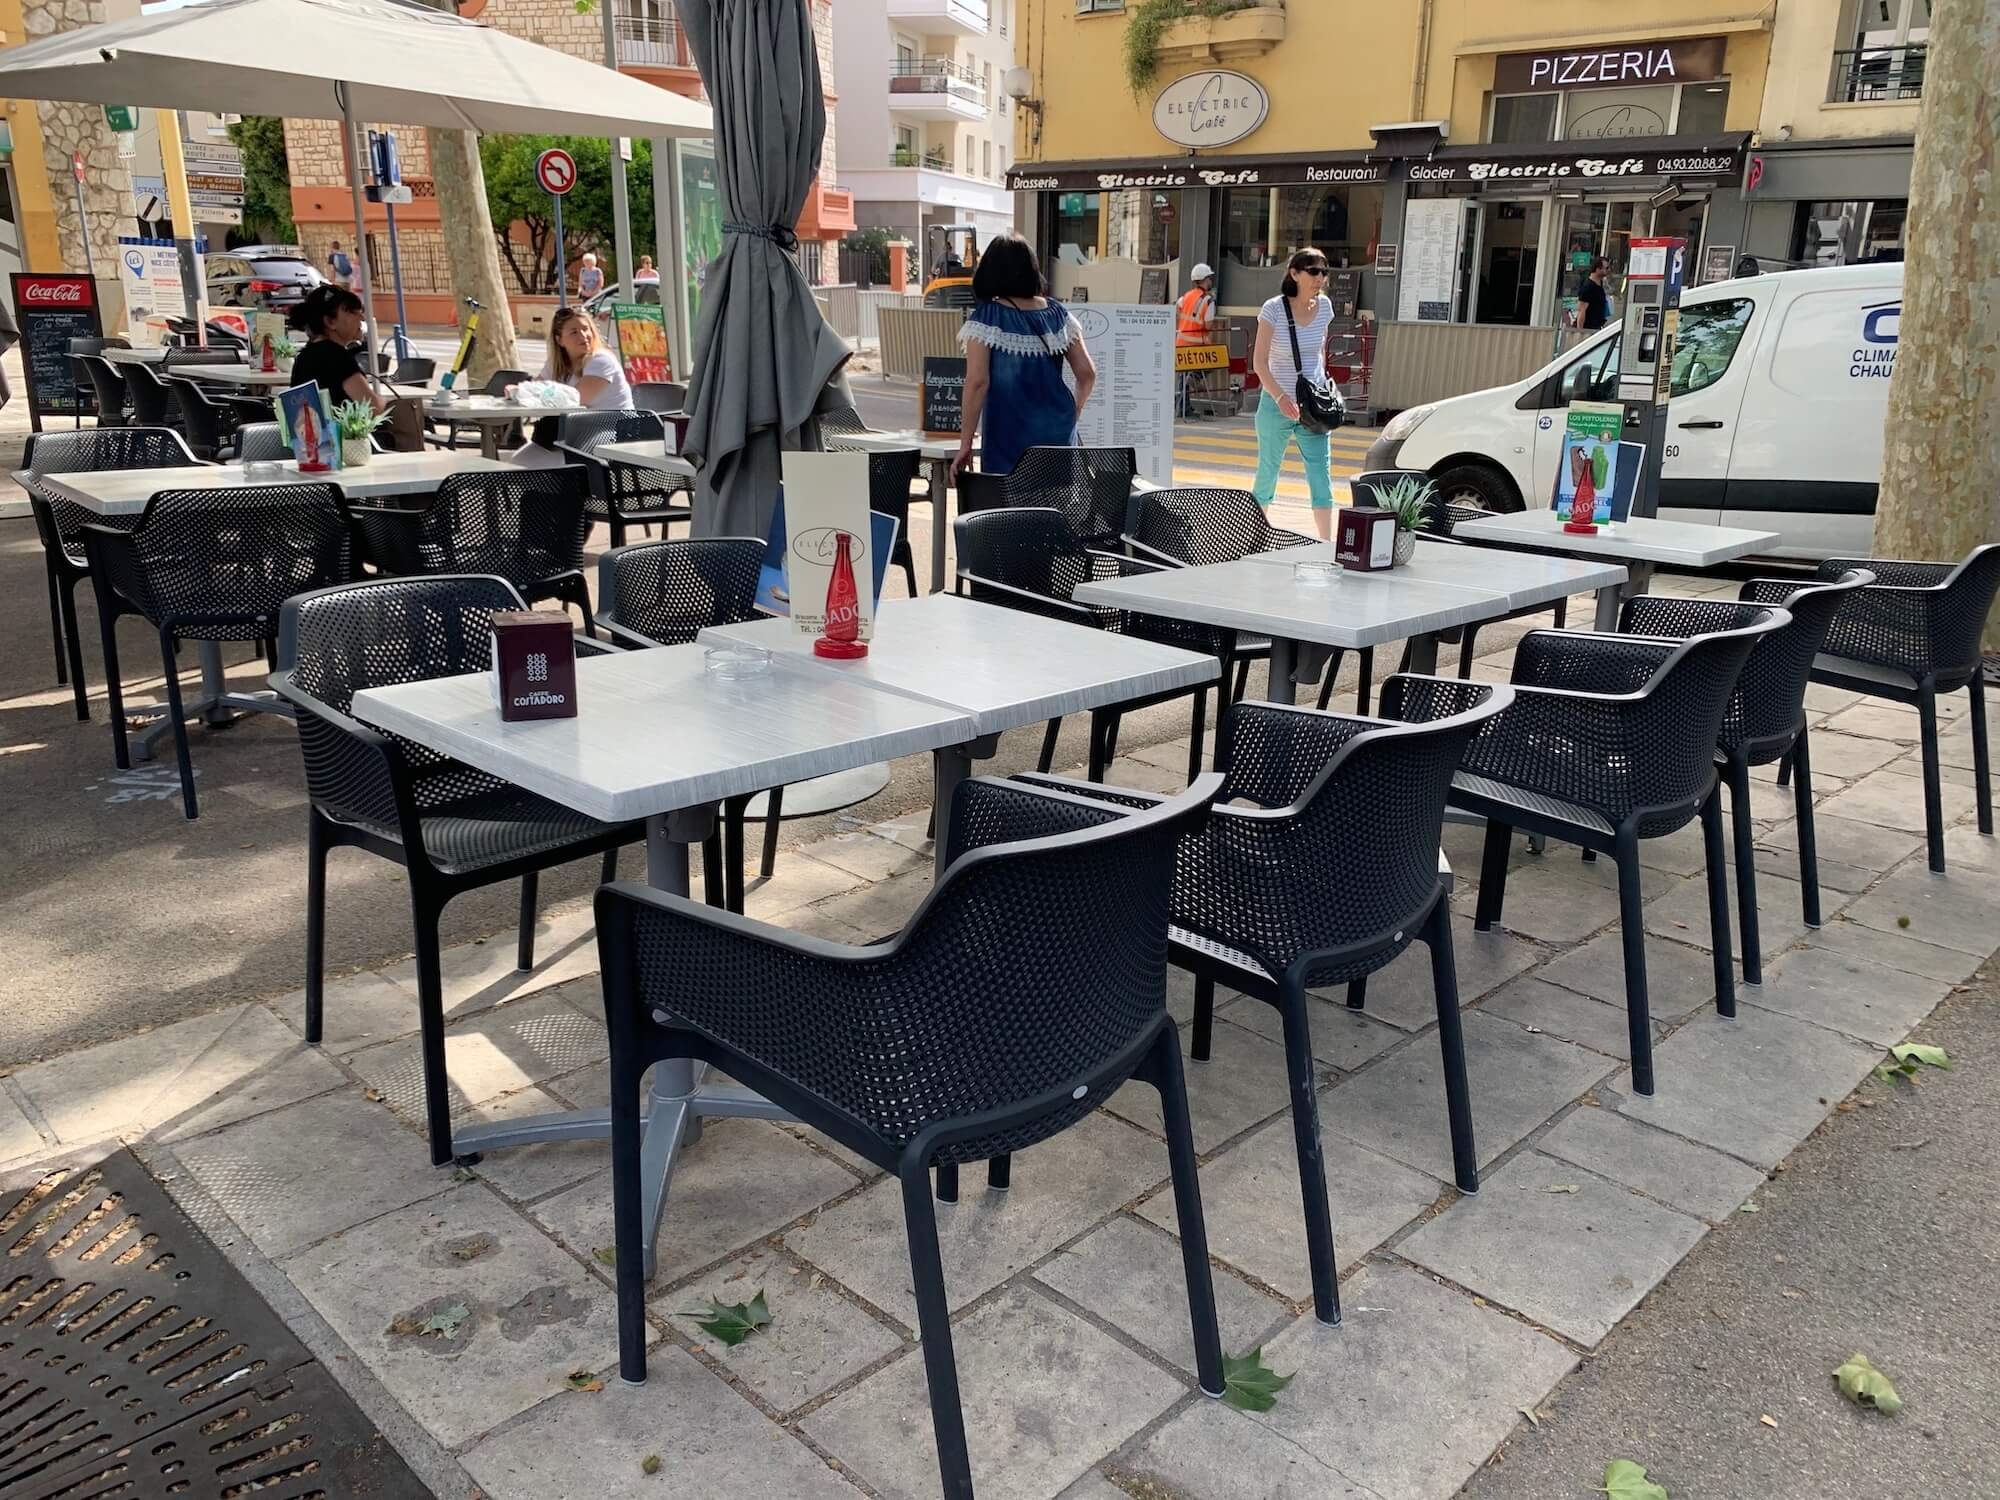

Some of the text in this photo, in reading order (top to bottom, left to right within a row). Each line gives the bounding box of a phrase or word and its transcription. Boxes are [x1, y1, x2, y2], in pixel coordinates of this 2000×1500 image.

[1531, 48, 1676, 85] PIZZERIA
[1168, 97, 1249, 114] ELECTRIC
[1576, 125, 1655, 138] ELECTRIC
[1410, 156, 1732, 180] Glacier Electric Café 04.93.20.88.29
[1013, 166, 1378, 189] Brasserie Electric Café Restaurant
[25, 283, 82, 301] Coca-Cola
[1177, 350, 1218, 365] PIÉTONS
[1849, 364, 1893, 378] CHAU
[1666, 445, 1680, 456] 60
[799, 540, 857, 550] ELECTC
[513, 694, 566, 707] COSTADORO
